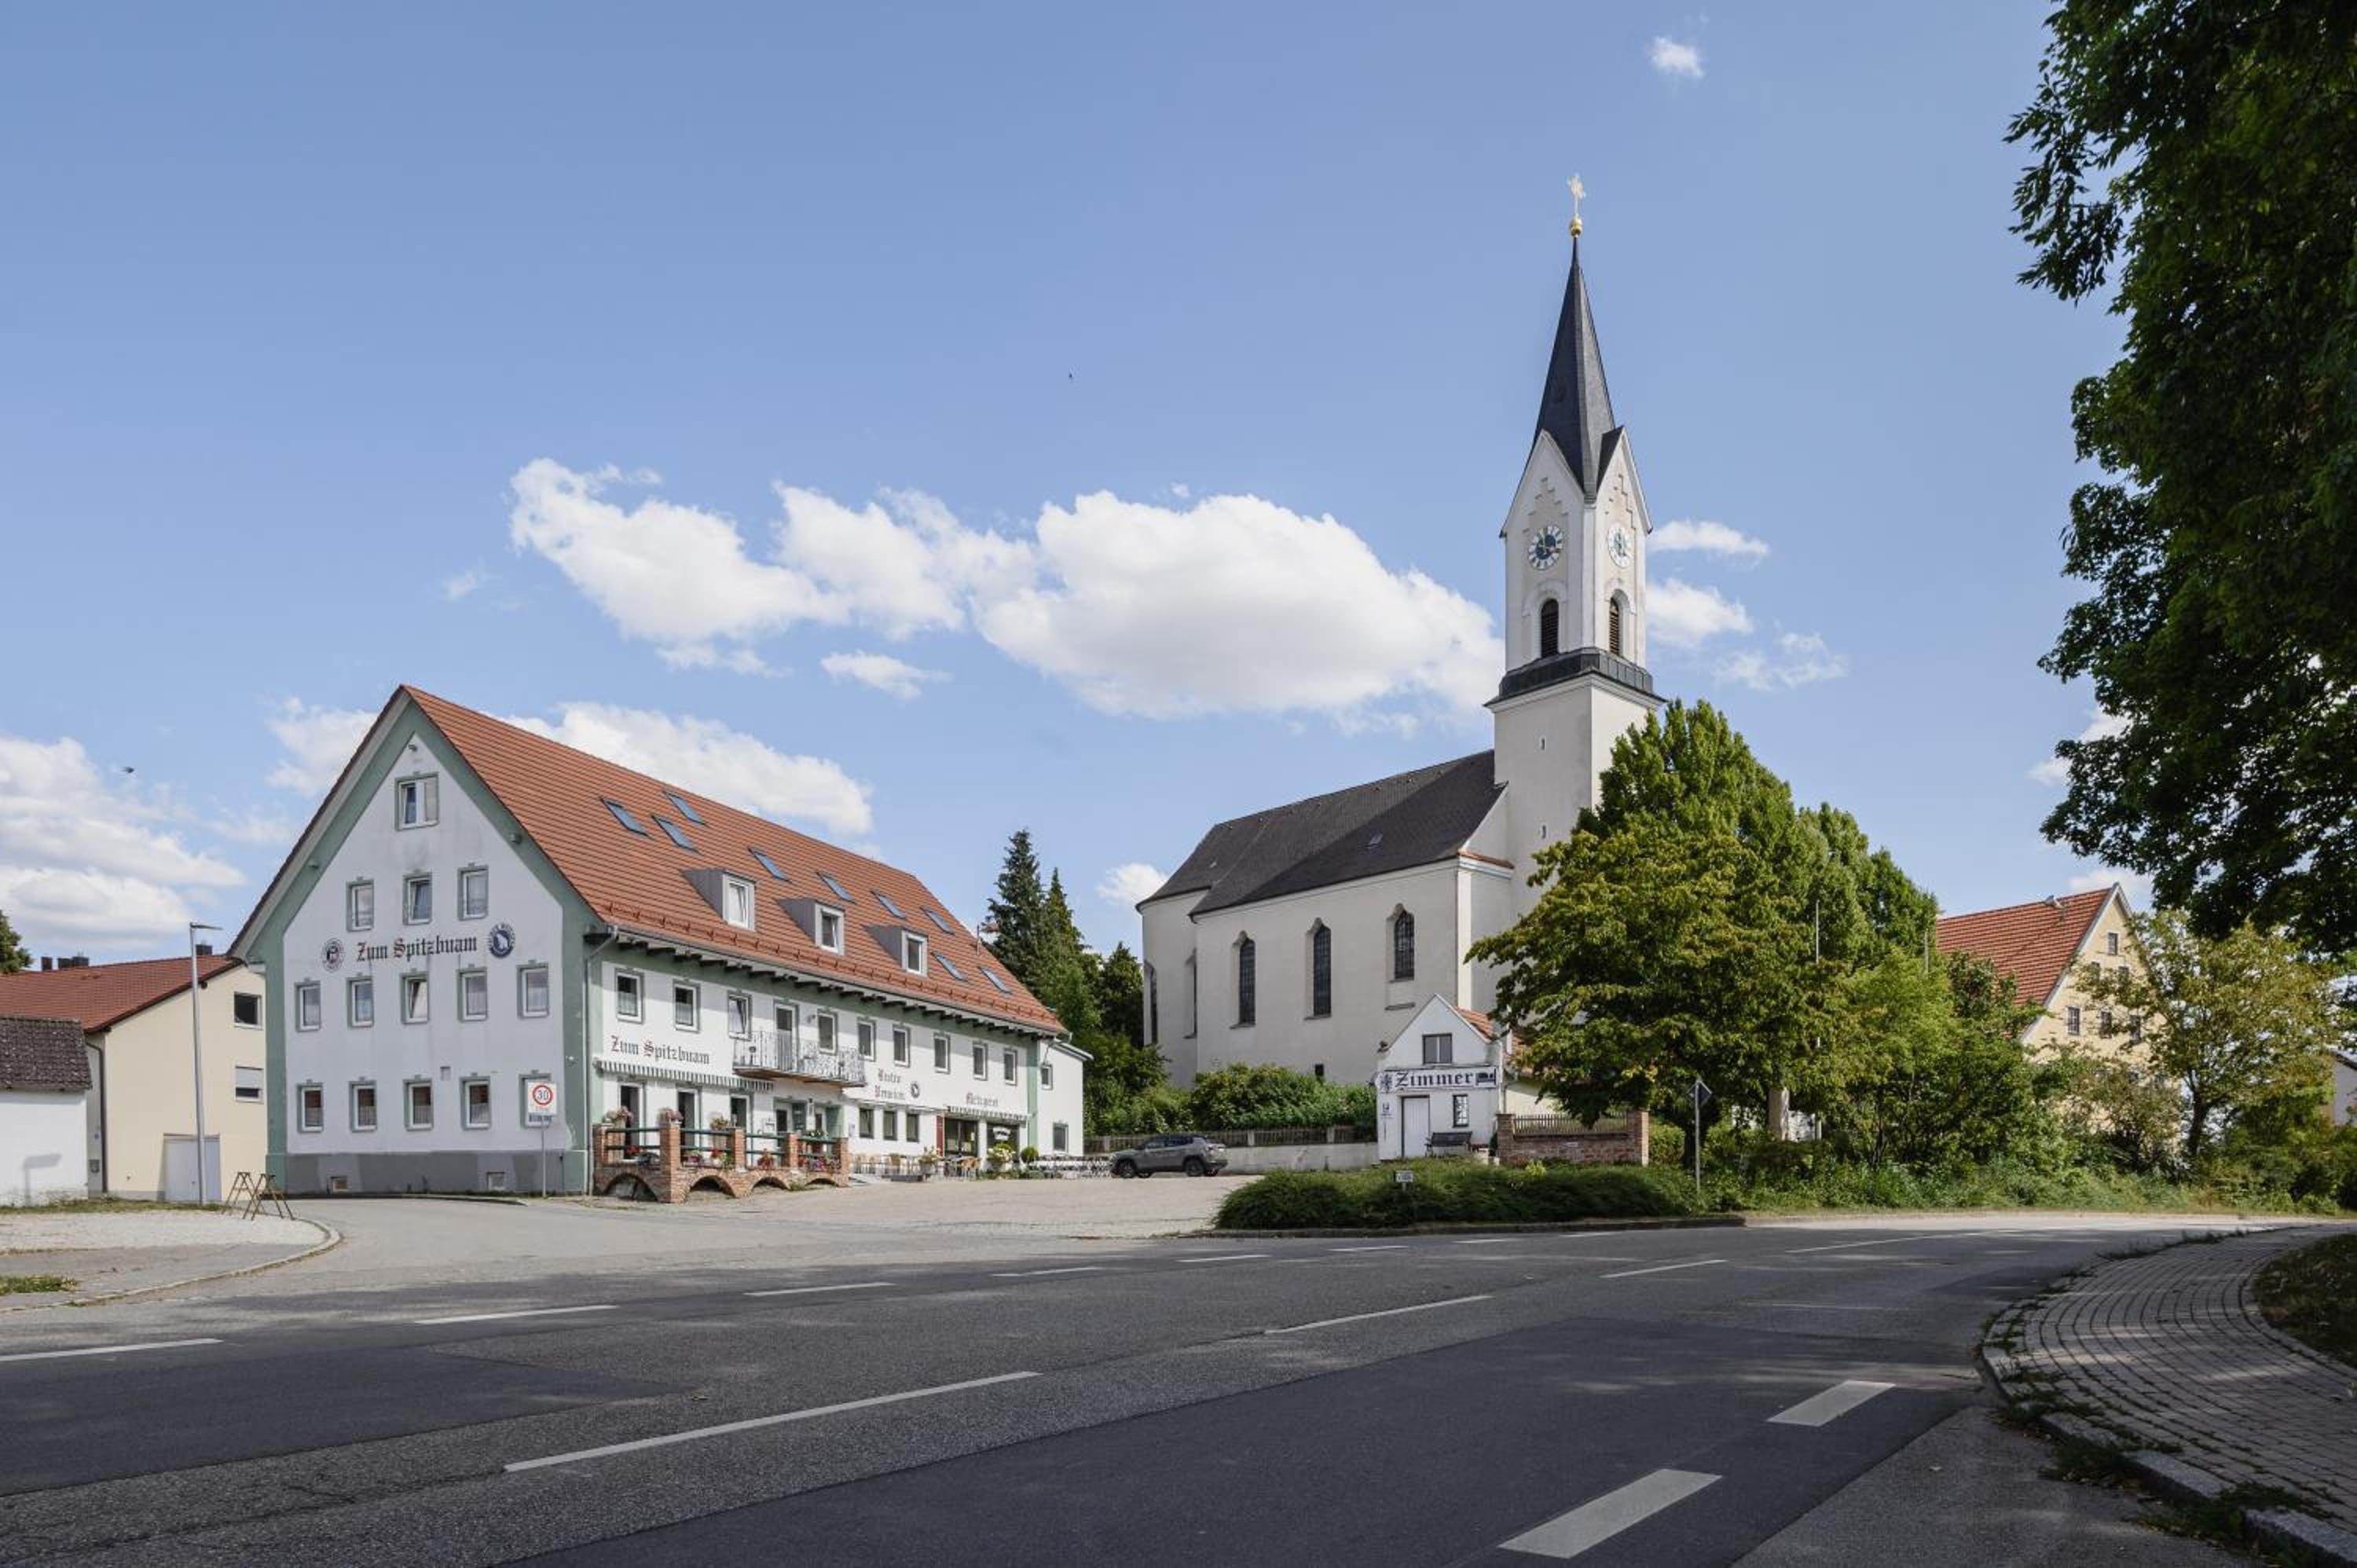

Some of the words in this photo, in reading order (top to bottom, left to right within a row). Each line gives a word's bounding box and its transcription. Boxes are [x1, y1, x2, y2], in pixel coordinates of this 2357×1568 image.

[357, 941, 387, 962] Zum
[394, 936, 477, 962] Spitzbuam
[610, 1035, 639, 1055] Zum
[643, 1041, 709, 1064] Spitzbuam
[1395, 1070, 1474, 1086] Zimmer
[537, 1090, 549, 1101] 30
